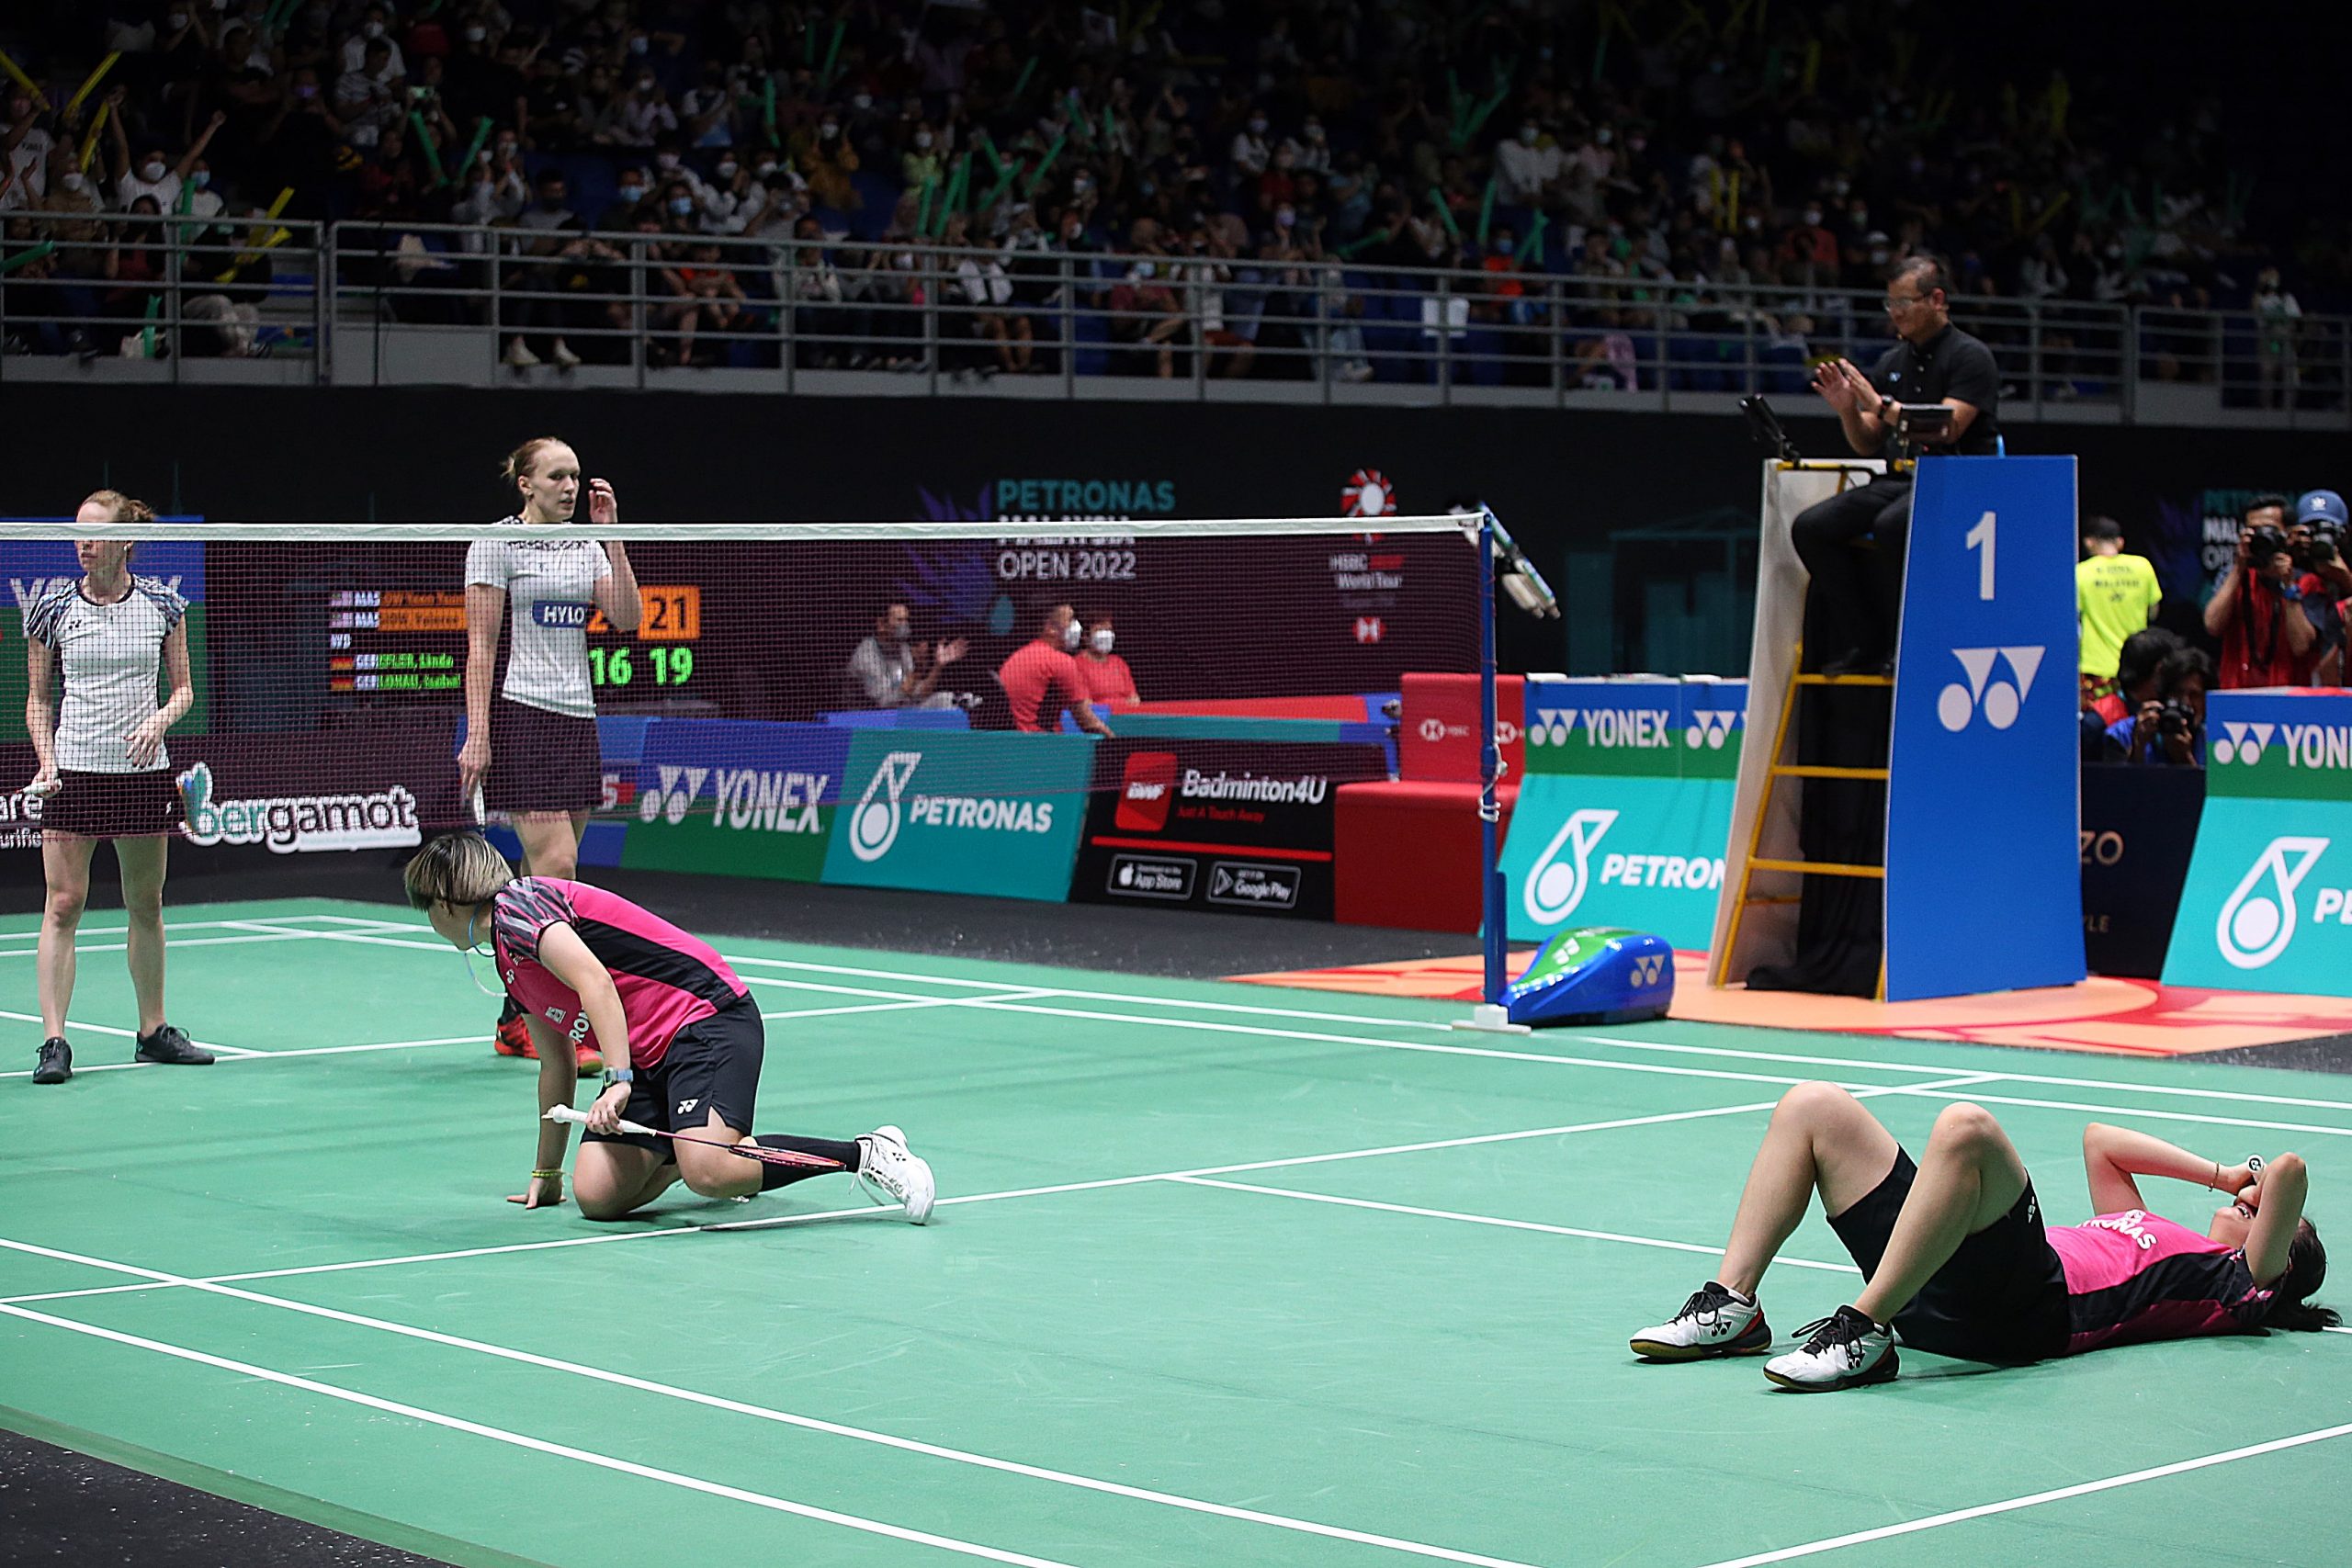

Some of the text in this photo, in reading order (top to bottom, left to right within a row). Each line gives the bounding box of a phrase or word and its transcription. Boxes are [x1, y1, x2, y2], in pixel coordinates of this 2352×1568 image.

[998, 479, 1176, 512] PETRONAS
[999, 551, 1136, 580] OPEN 2022
[1966, 510, 1996, 601] 1
[544, 605, 585, 625] HYLO
[649, 597, 687, 630] 21
[589, 646, 693, 685] 16 19
[1582, 709, 1670, 749] YONEX
[2281, 724, 2352, 769] YON
[178, 763, 419, 847] bergamot
[713, 768, 831, 834] YONEX
[1181, 769, 1328, 805] Badminton4U
[908, 794, 1054, 833] PETRONAS
[1134, 873, 1182, 891] App Store
